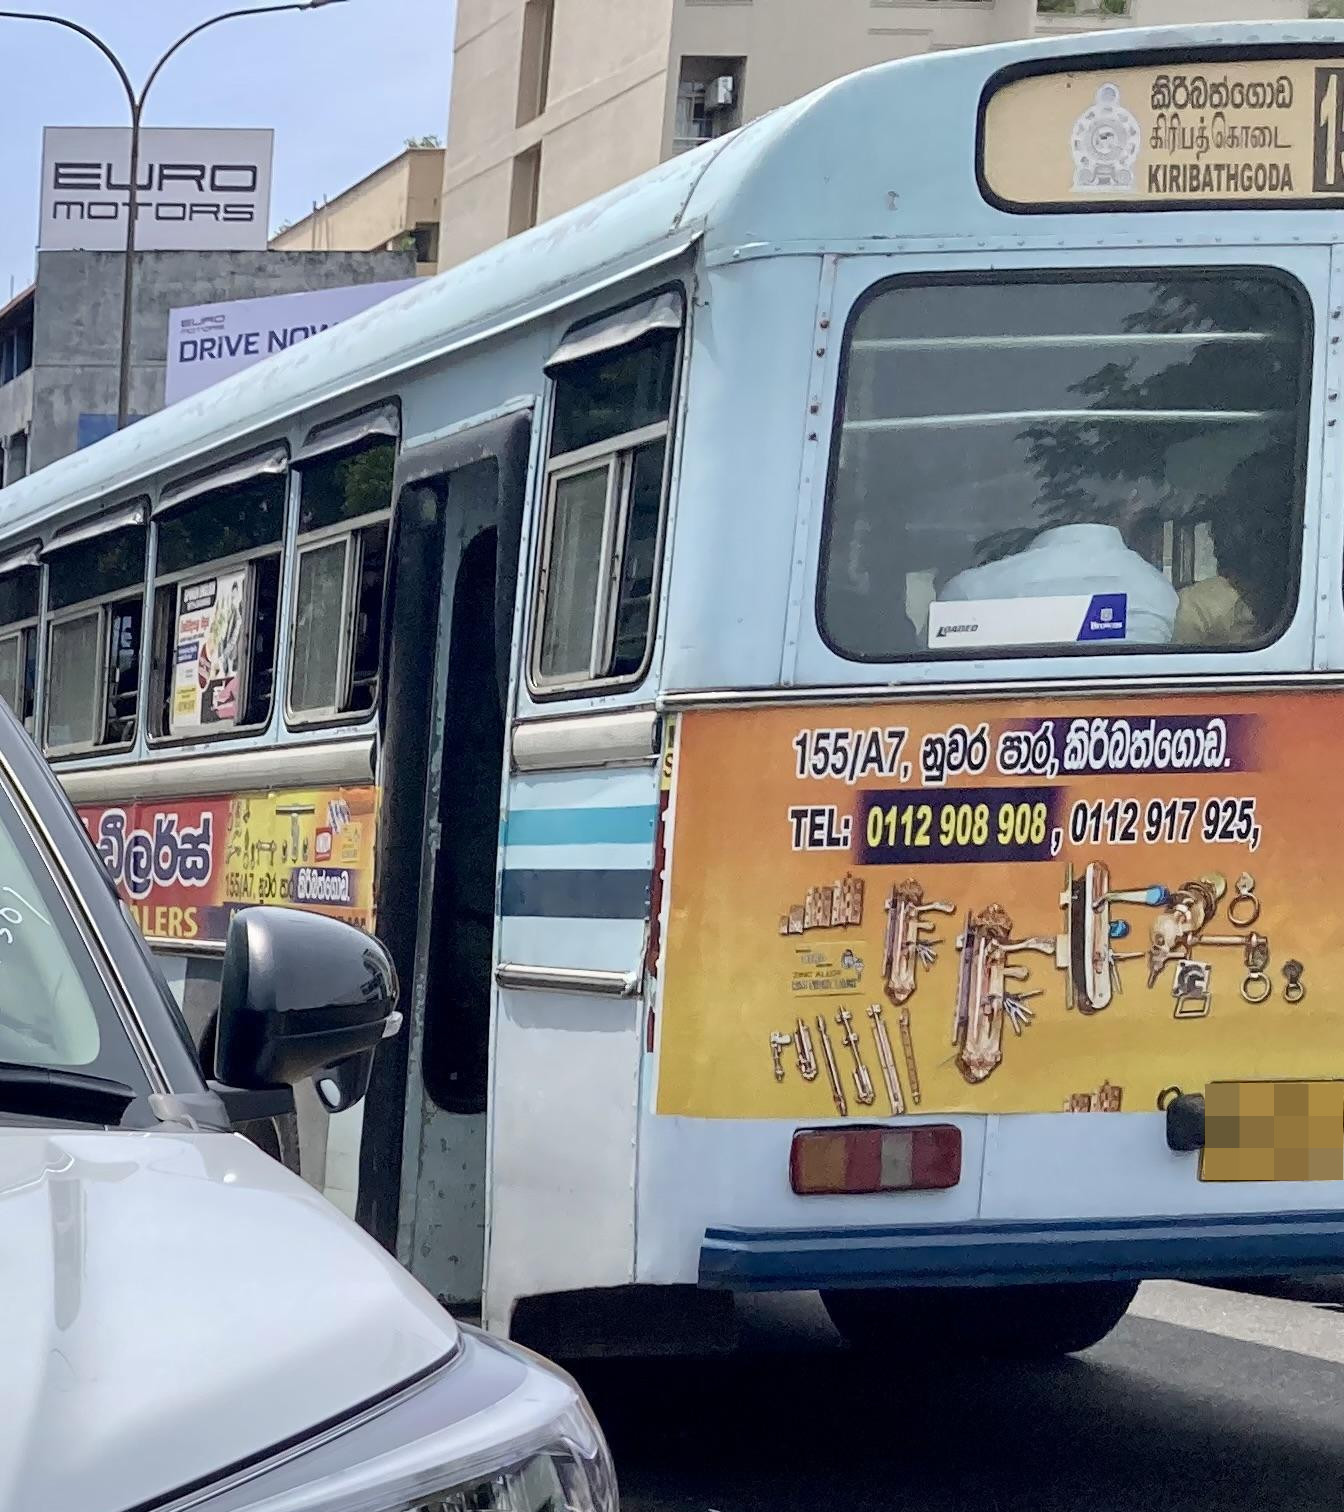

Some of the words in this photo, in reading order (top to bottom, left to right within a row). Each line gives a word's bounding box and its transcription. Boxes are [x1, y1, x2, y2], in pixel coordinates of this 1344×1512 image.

[53, 161, 258, 193] EURO
[1147, 162, 1295, 194] KIRIBATHGODA
[52, 201, 255, 223] MOTORS
[178, 331, 260, 363] DRIVE
[793, 728, 911, 783] 155/A7,
[789, 806, 853, 849] TEL:
[866, 804, 931, 848] 0112
[939, 803, 989, 847] 908
[997, 802, 1047, 846] 908
[1070, 798, 1136, 845] 0112
[1145, 797, 1197, 844] 917
[1201, 796, 1261, 850] 925,
